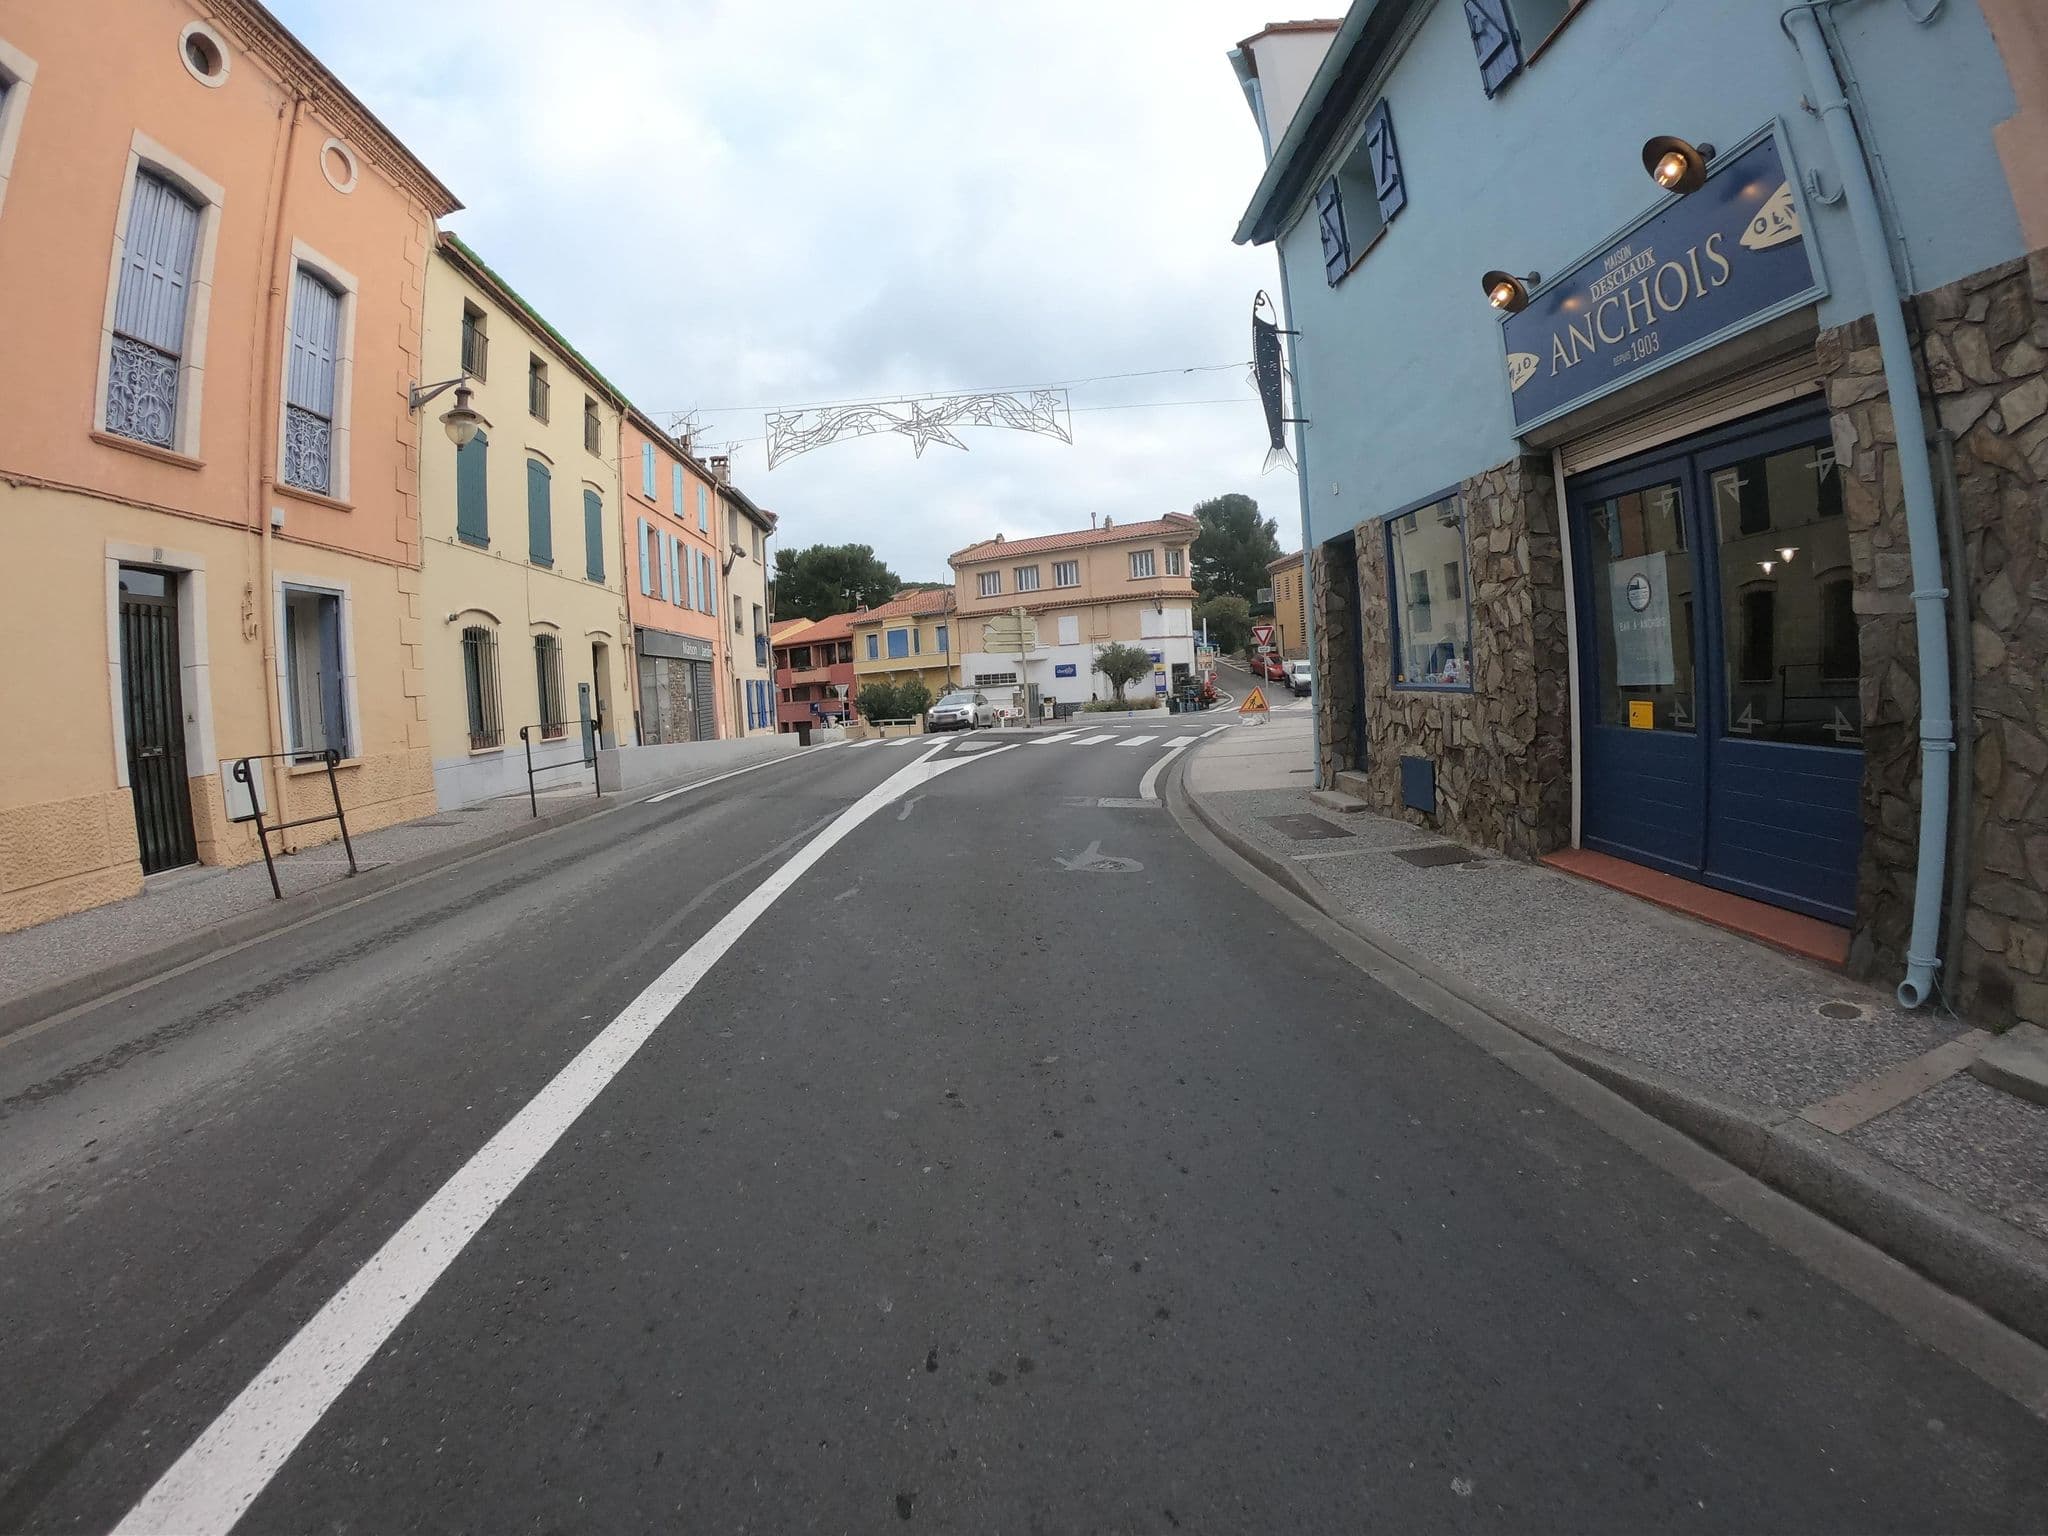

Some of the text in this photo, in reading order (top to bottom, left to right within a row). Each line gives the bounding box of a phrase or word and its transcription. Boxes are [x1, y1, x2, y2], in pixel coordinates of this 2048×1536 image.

[1590, 248, 1656, 303] DESCLAUX
[1603, 244, 1632, 272] MAISON
[1550, 232, 1730, 377] ANCHOIS
[1630, 331, 1660, 362] 1903
